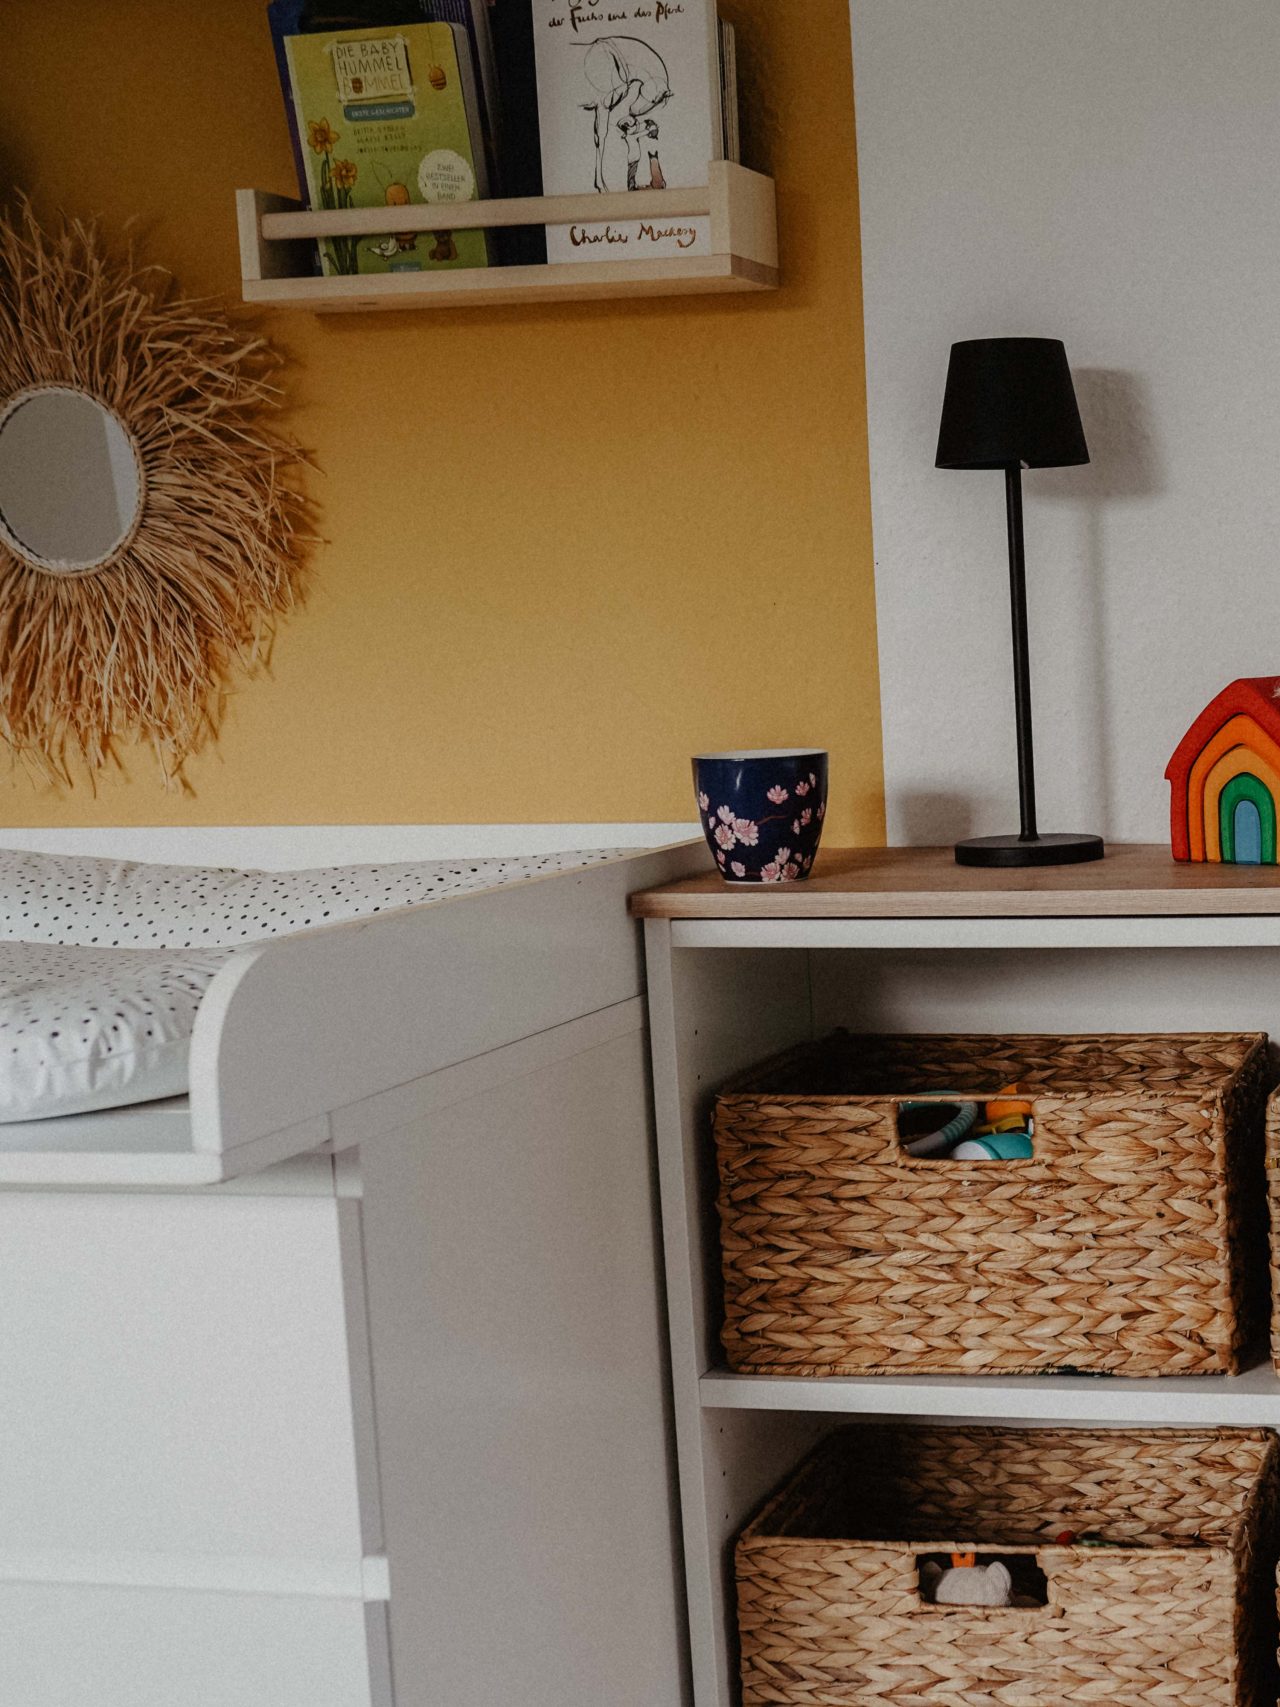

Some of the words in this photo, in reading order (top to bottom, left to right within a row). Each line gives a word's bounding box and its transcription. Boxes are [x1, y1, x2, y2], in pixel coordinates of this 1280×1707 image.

[549, 18, 565, 28] der
[570, 6, 603, 33] Fuchs
[608, 12, 627, 22] und
[634, 7, 651, 18] das
[655, 1, 685, 23] Pferd
[336, 46, 354, 59] DIE
[360, 42, 399, 57] BABY
[338, 57, 403, 76] HUMMEL
[569, 225, 628, 247] Charlie
